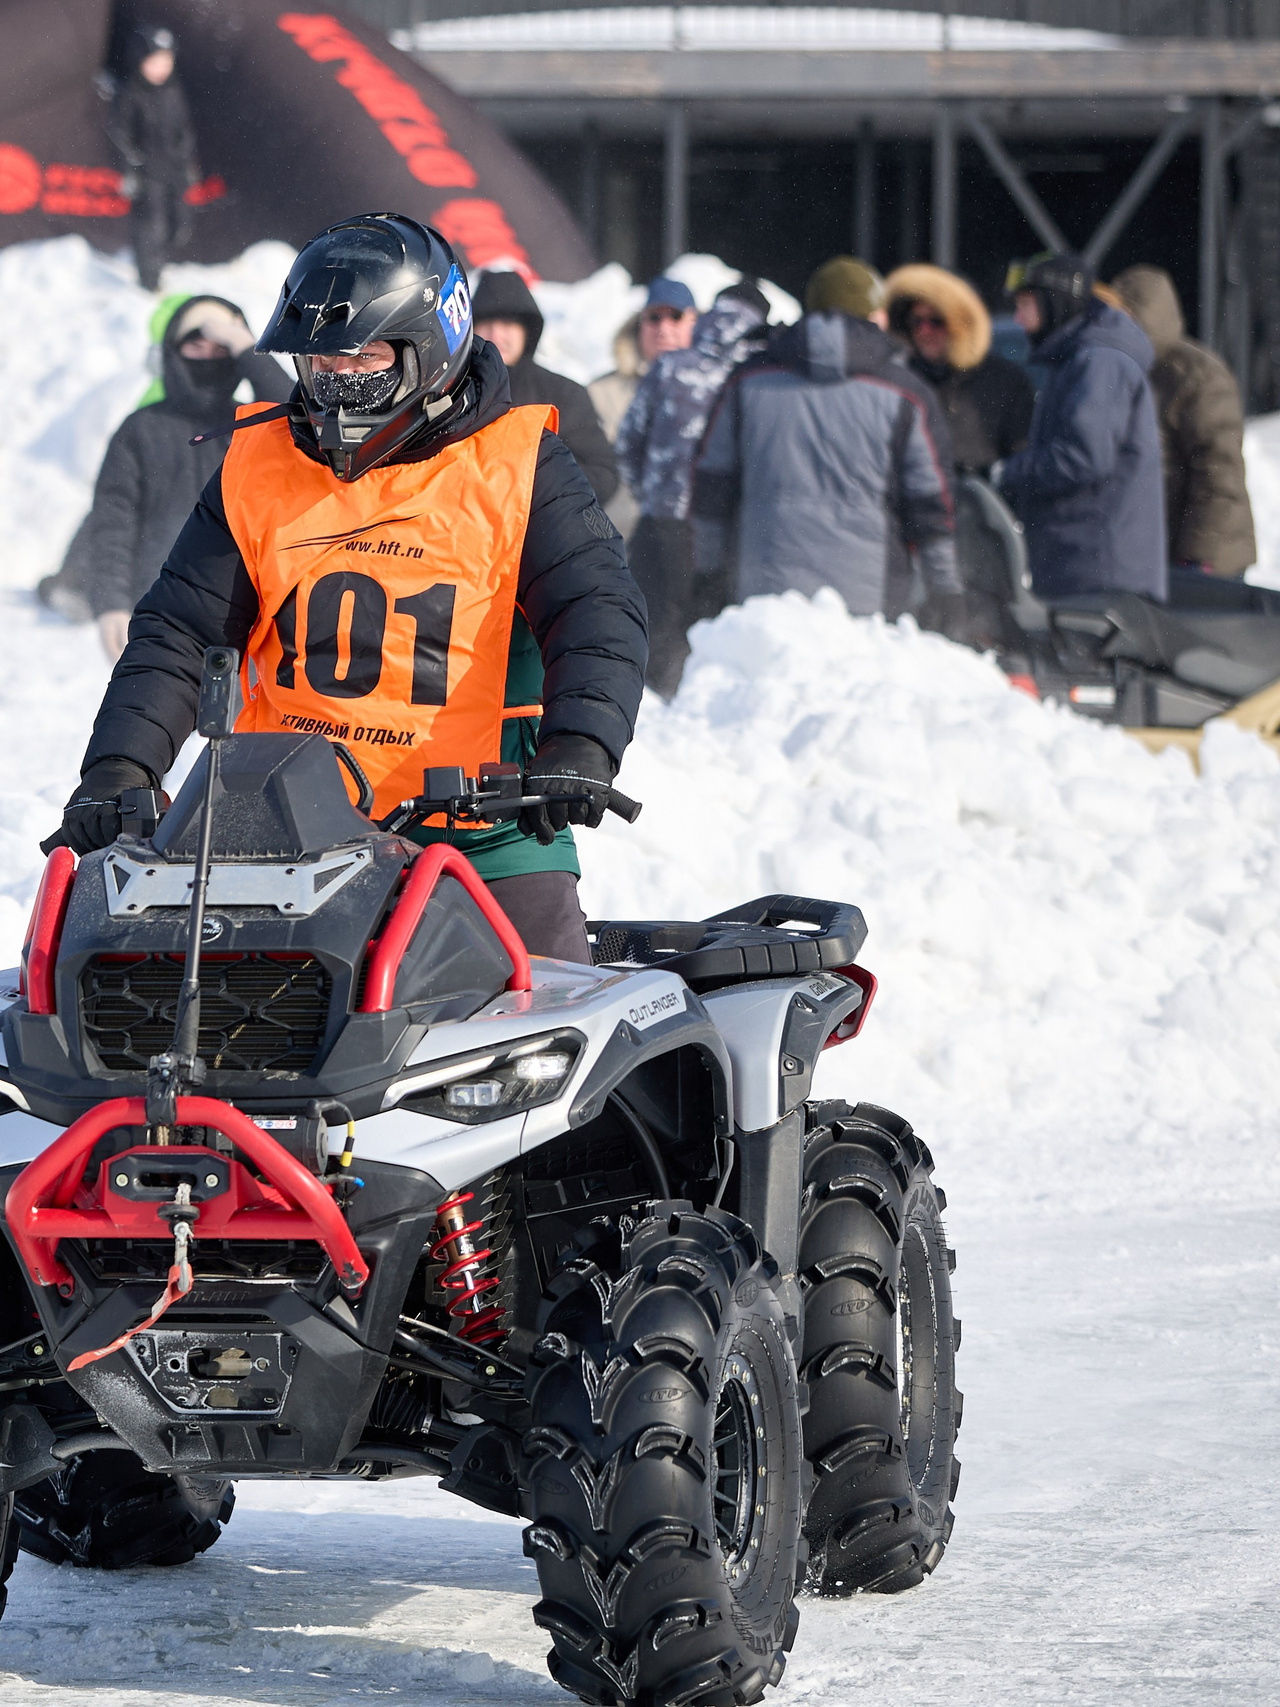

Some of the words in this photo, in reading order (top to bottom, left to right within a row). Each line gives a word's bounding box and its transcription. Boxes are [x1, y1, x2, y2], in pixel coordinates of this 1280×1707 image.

[442, 281, 470, 336] 70
[338, 540, 424, 559] ww.hft.ru
[272, 571, 457, 707] 101
[280, 714, 350, 740] КТИВНЫЙ
[354, 726, 416, 747] ОТДЫХ
